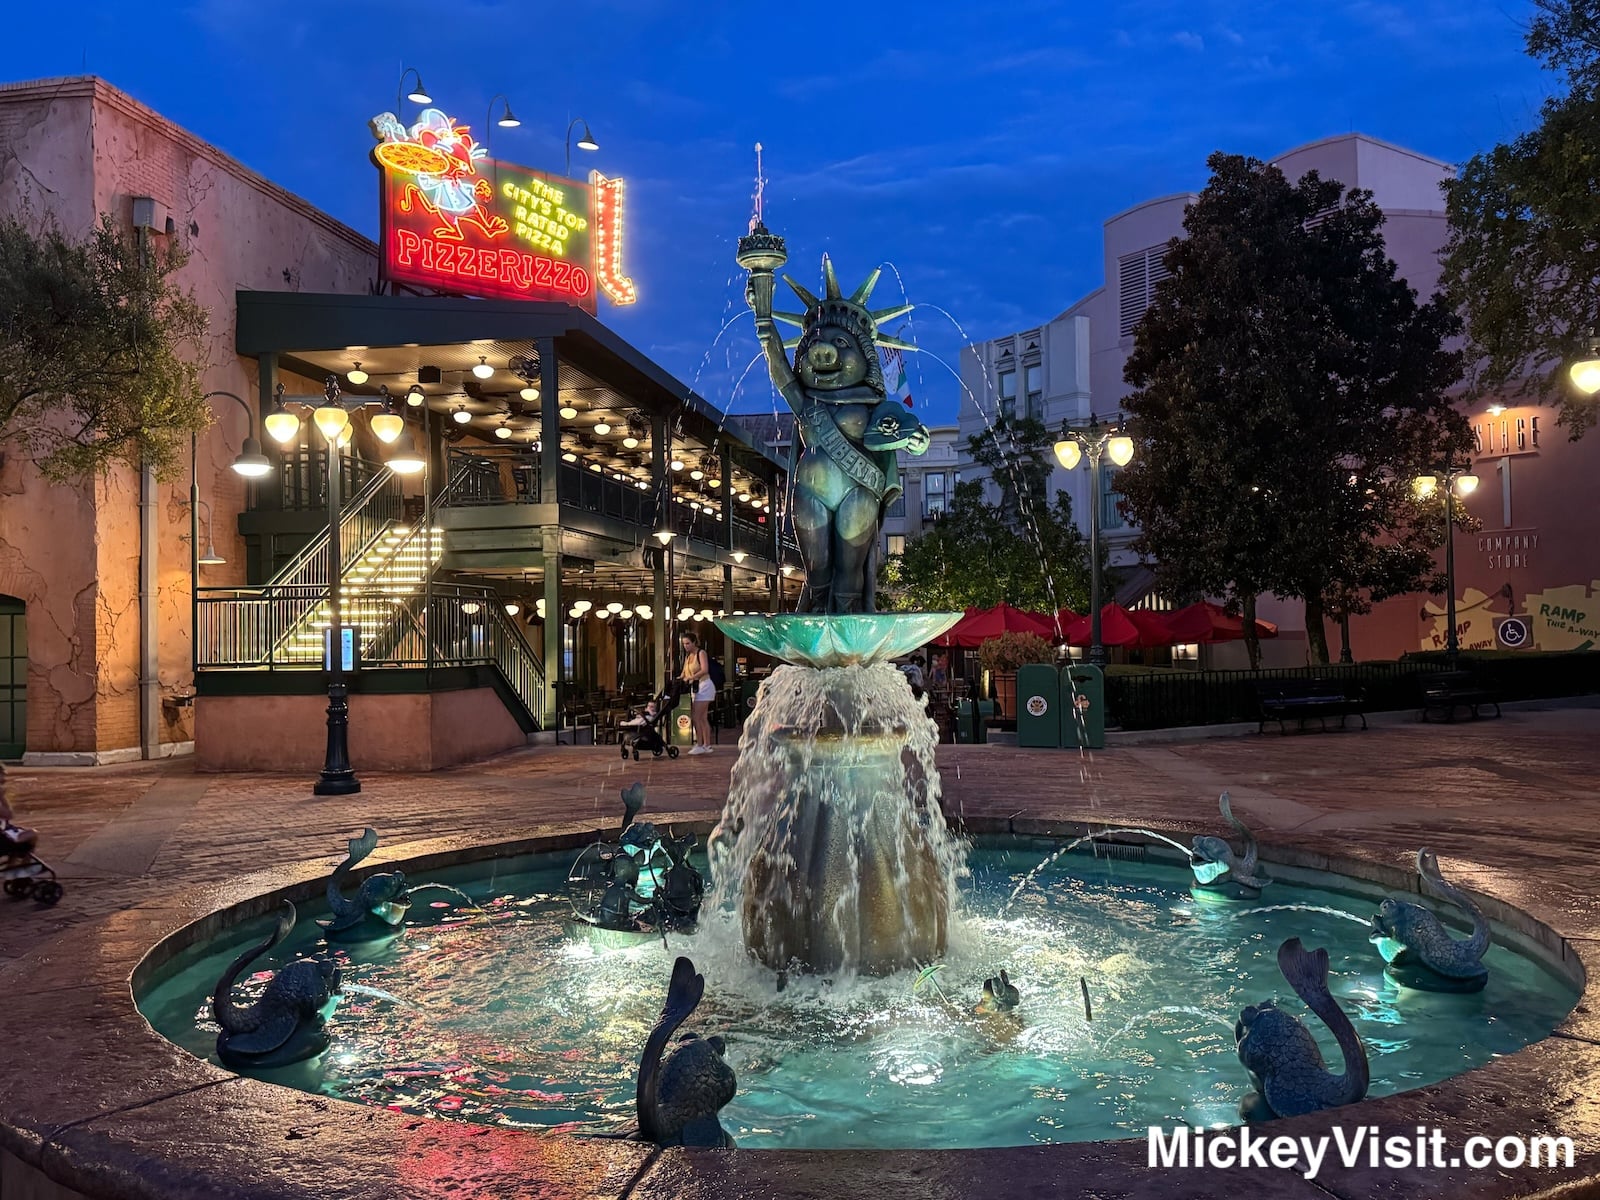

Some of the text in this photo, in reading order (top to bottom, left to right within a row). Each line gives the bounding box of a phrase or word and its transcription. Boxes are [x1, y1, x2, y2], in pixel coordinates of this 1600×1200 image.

[502, 183, 587, 232] CITY'S TOP
[532, 179, 564, 205] THE
[515, 205, 569, 240] RATED
[515, 222, 563, 256] PIZZA
[398, 229, 589, 296] PIZZERIZZO
[1474, 415, 1540, 452] STAGE
[821, 428, 884, 489] LIBERTY
[1497, 455, 1511, 529] 1
[1478, 535, 1538, 552] COMPANY
[1488, 554, 1528, 569] STORE
[1540, 603, 1586, 623] RAMP
